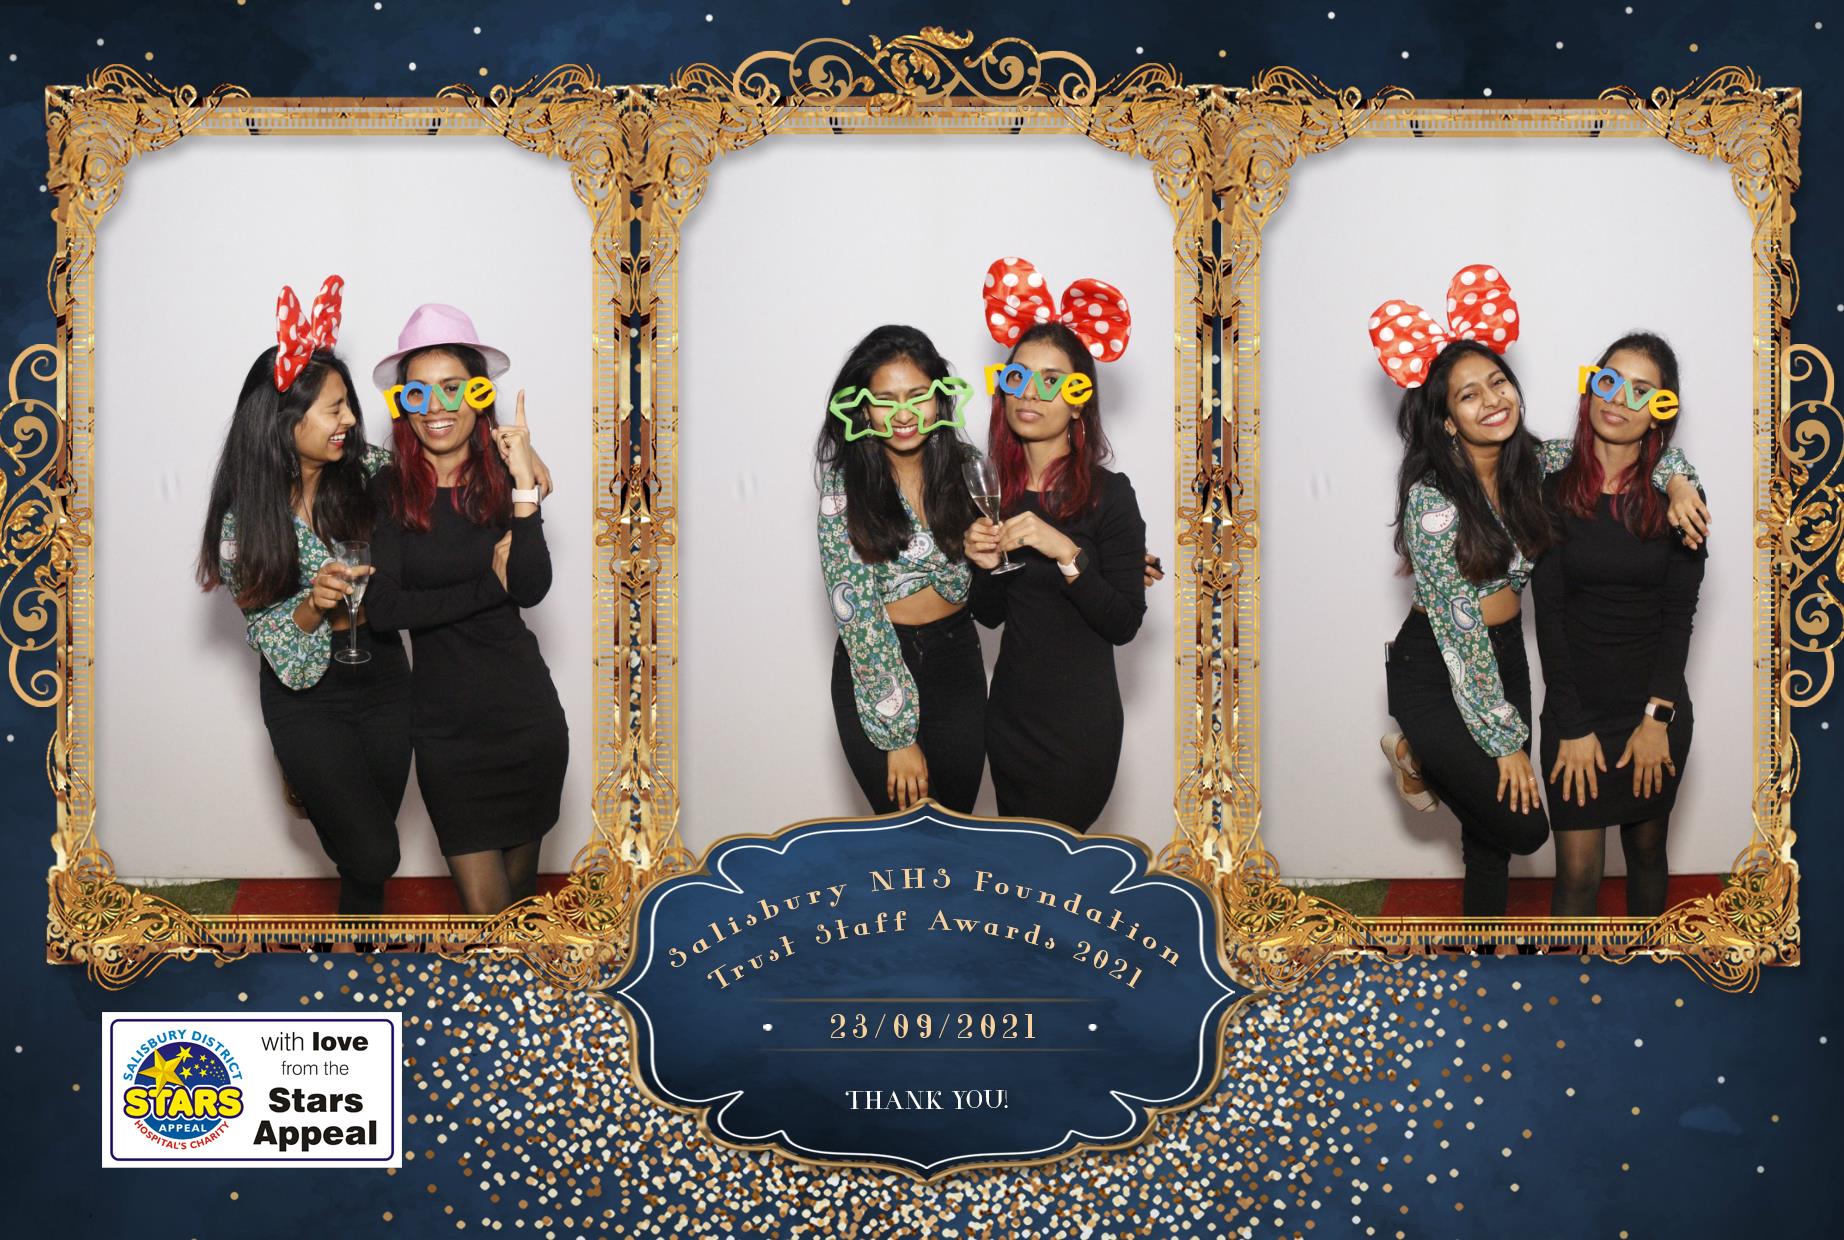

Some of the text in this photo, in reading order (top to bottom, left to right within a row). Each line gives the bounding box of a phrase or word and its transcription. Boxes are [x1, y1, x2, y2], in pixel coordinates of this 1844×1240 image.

[383, 376, 496, 419] rave
[984, 362, 1093, 405] rave
[1578, 365, 1679, 420] rave
